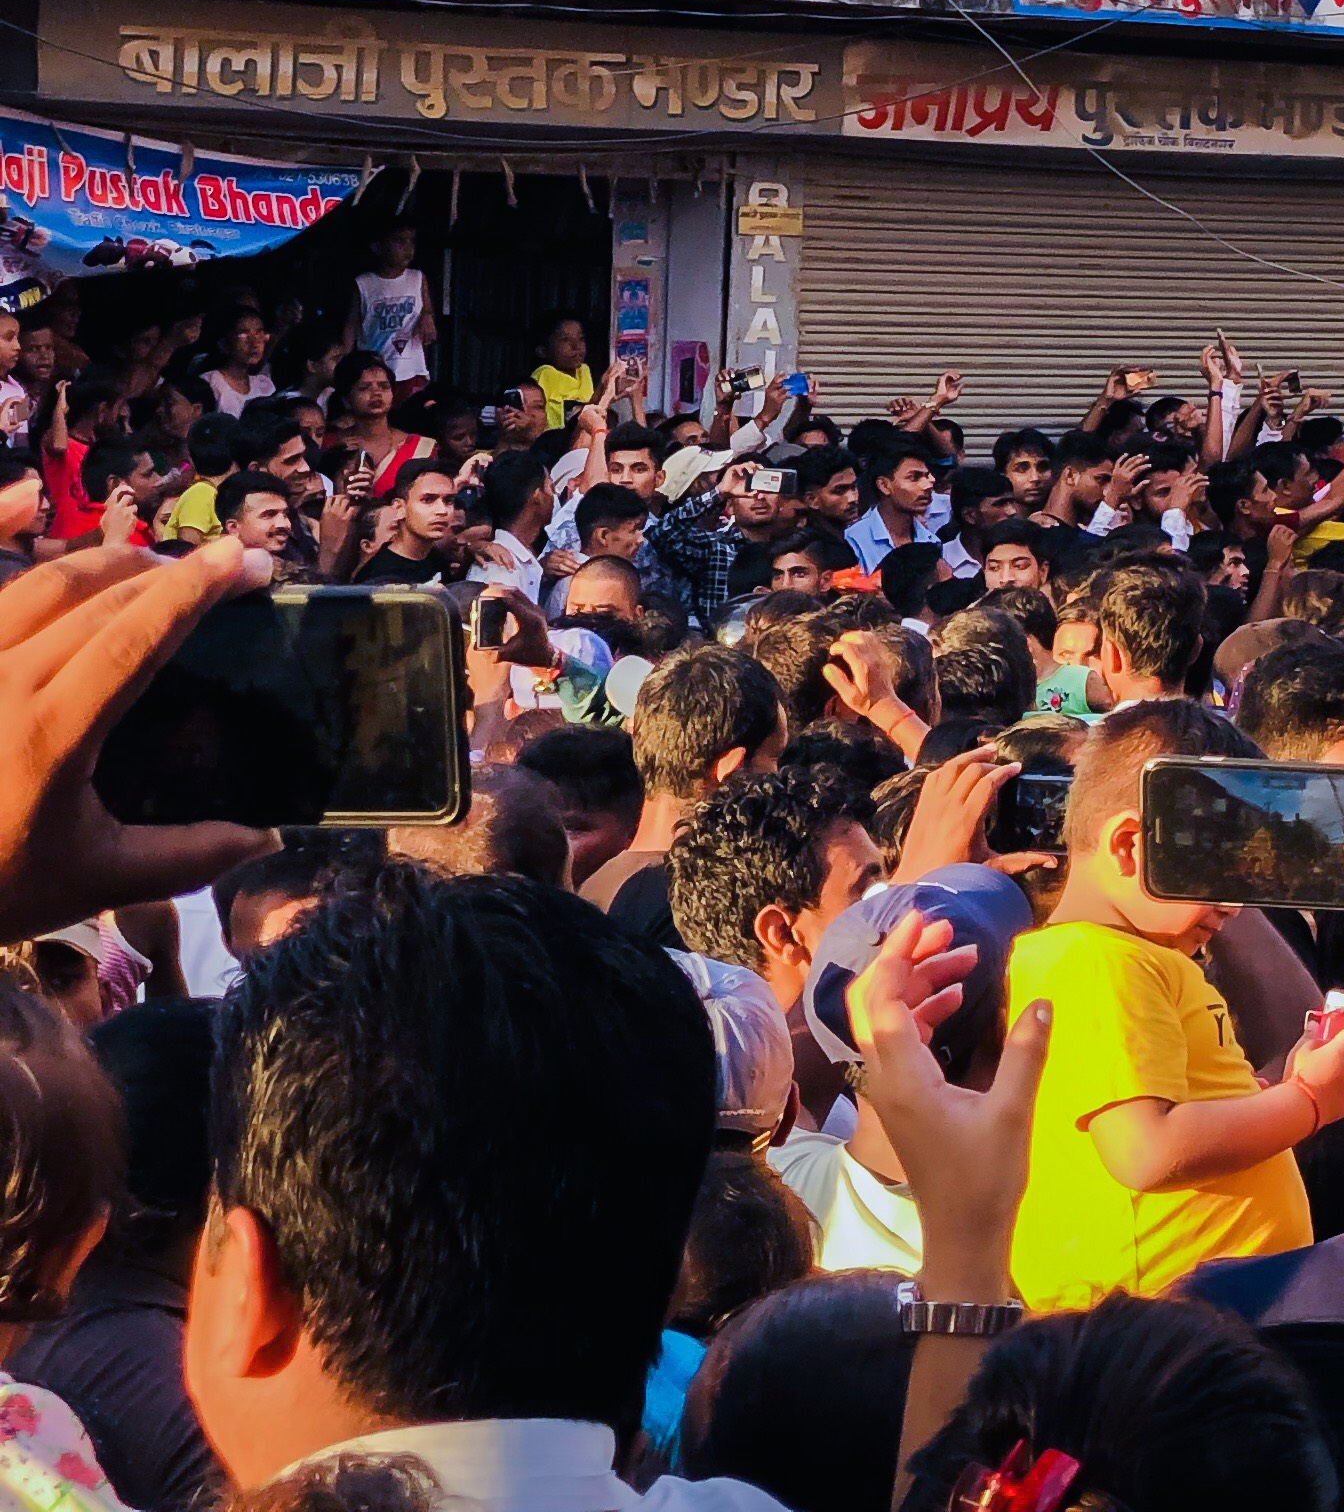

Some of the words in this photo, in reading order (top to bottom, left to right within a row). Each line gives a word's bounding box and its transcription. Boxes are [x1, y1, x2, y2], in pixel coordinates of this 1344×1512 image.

[118, 18, 388, 103] बालाजी
[398, 42, 627, 119] पुस्तक
[631, 52, 820, 123] भण्डार
